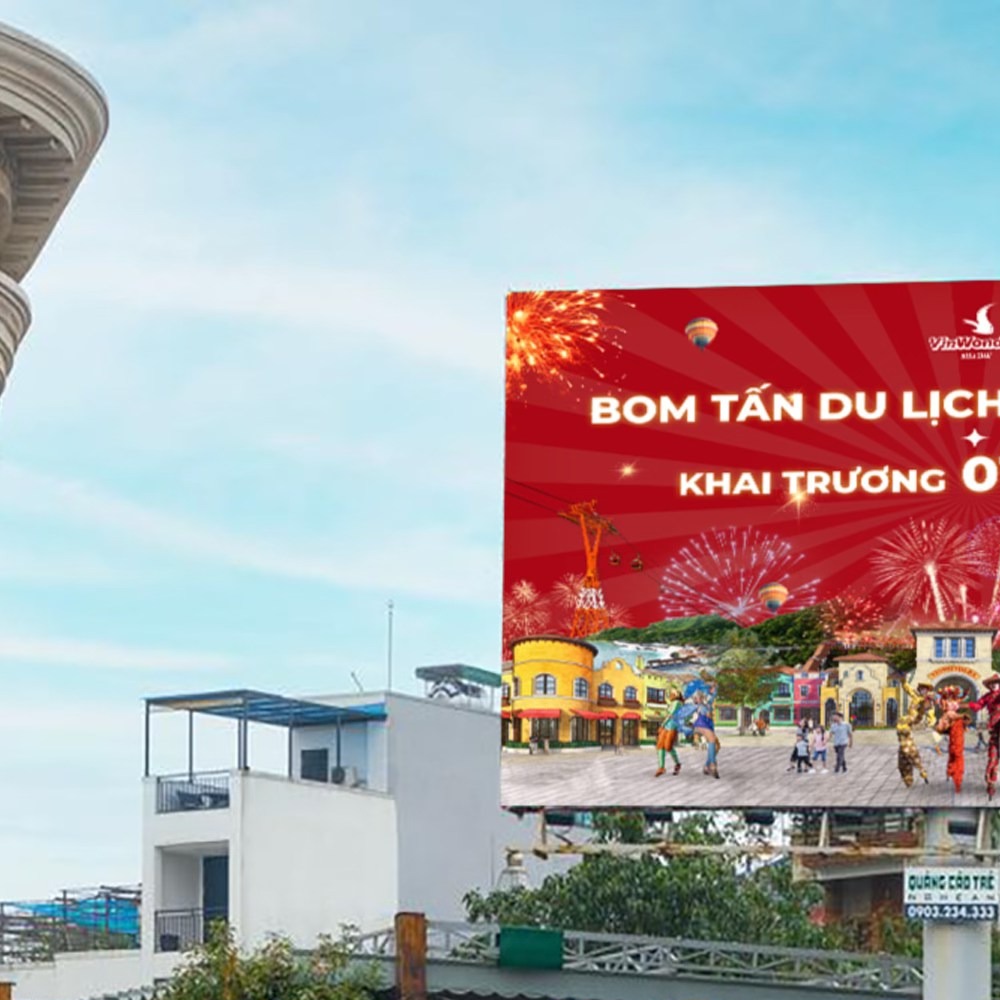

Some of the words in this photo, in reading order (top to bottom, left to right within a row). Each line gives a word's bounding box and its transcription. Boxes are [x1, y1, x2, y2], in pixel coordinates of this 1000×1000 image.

[590, 395, 696, 425] BOM
[712, 382, 804, 423] TẤN
[819, 391, 887, 422] DU
[678, 471, 772, 497] KHAI
[782, 466, 946, 497] TRƯƠNG
